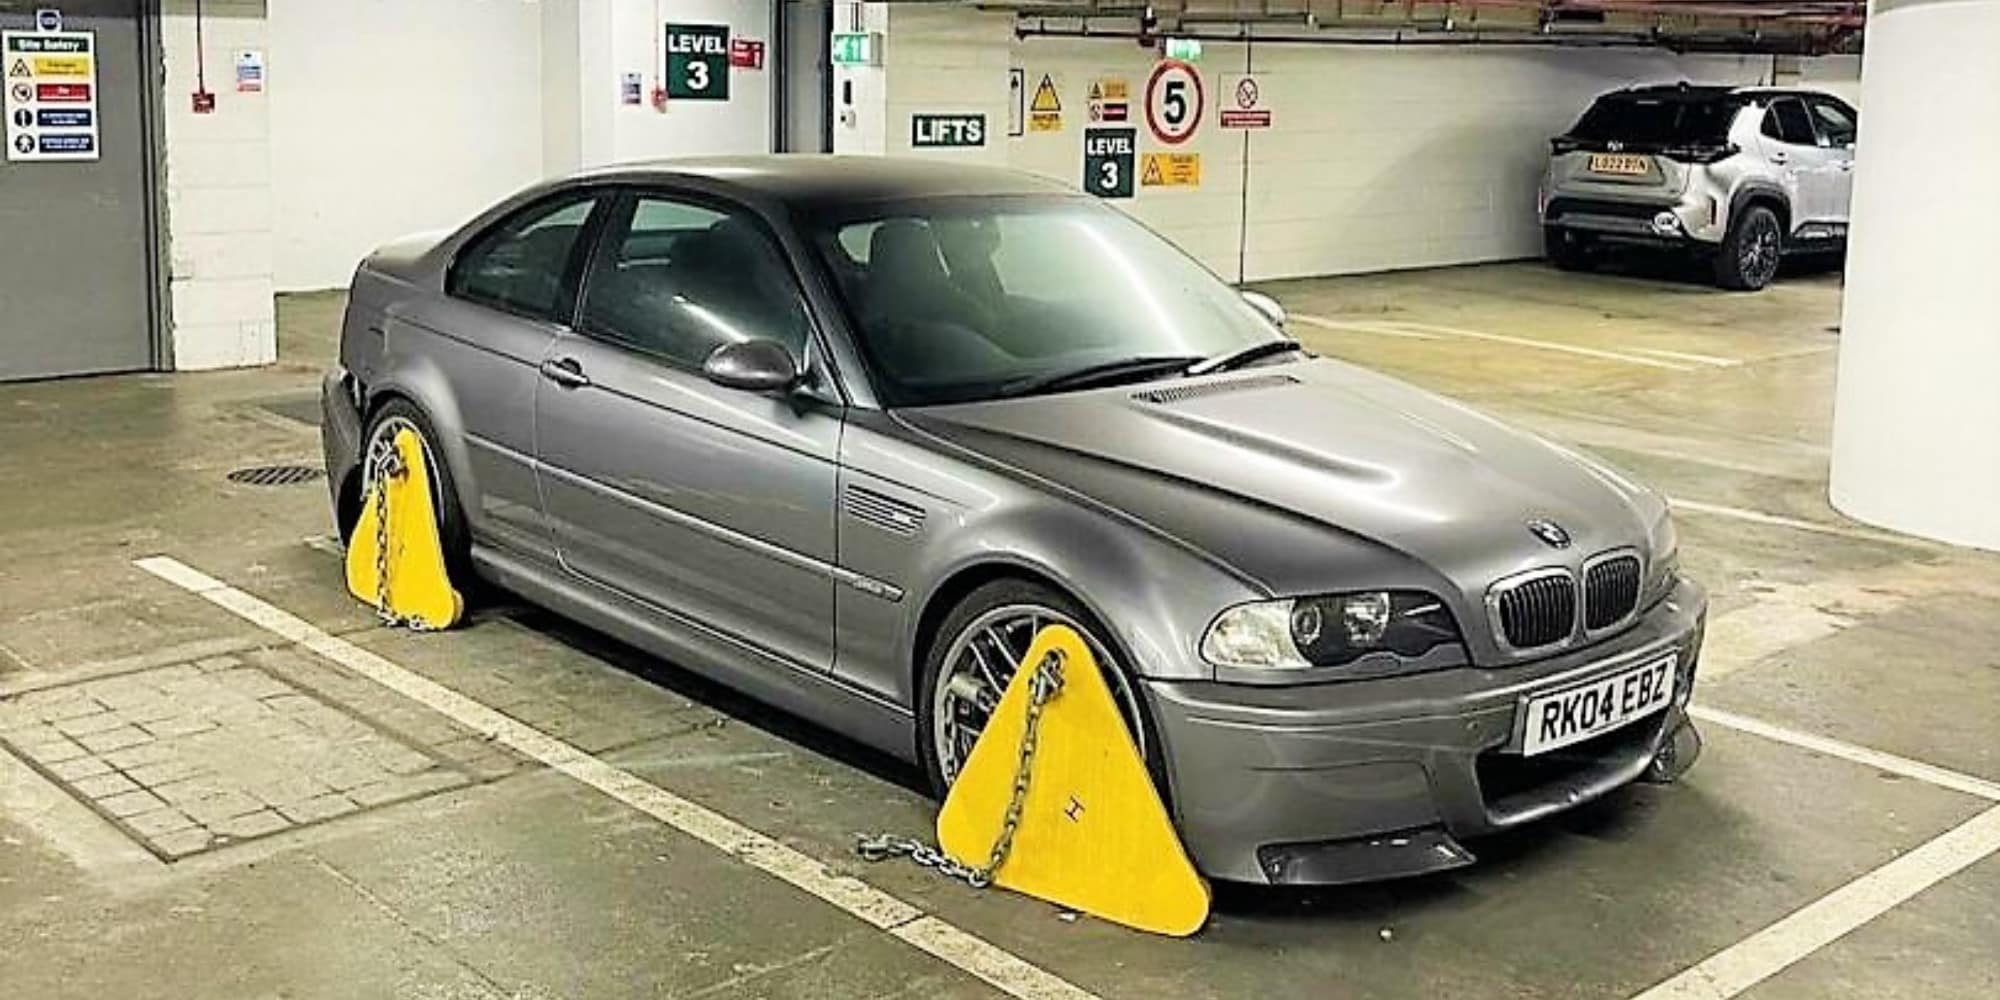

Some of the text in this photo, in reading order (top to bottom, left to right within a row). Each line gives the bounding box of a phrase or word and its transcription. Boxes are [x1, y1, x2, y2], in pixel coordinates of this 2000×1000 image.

[667, 34, 726, 53] LEVEL
[686, 60, 709, 90] 3
[1164, 80, 1186, 124] 5
[916, 119, 982, 142] LIFTS
[1087, 138, 1132, 155] LEVEL
[1101, 162, 1118, 189] 3
[1539, 661, 1668, 742] RK04 EBZ
